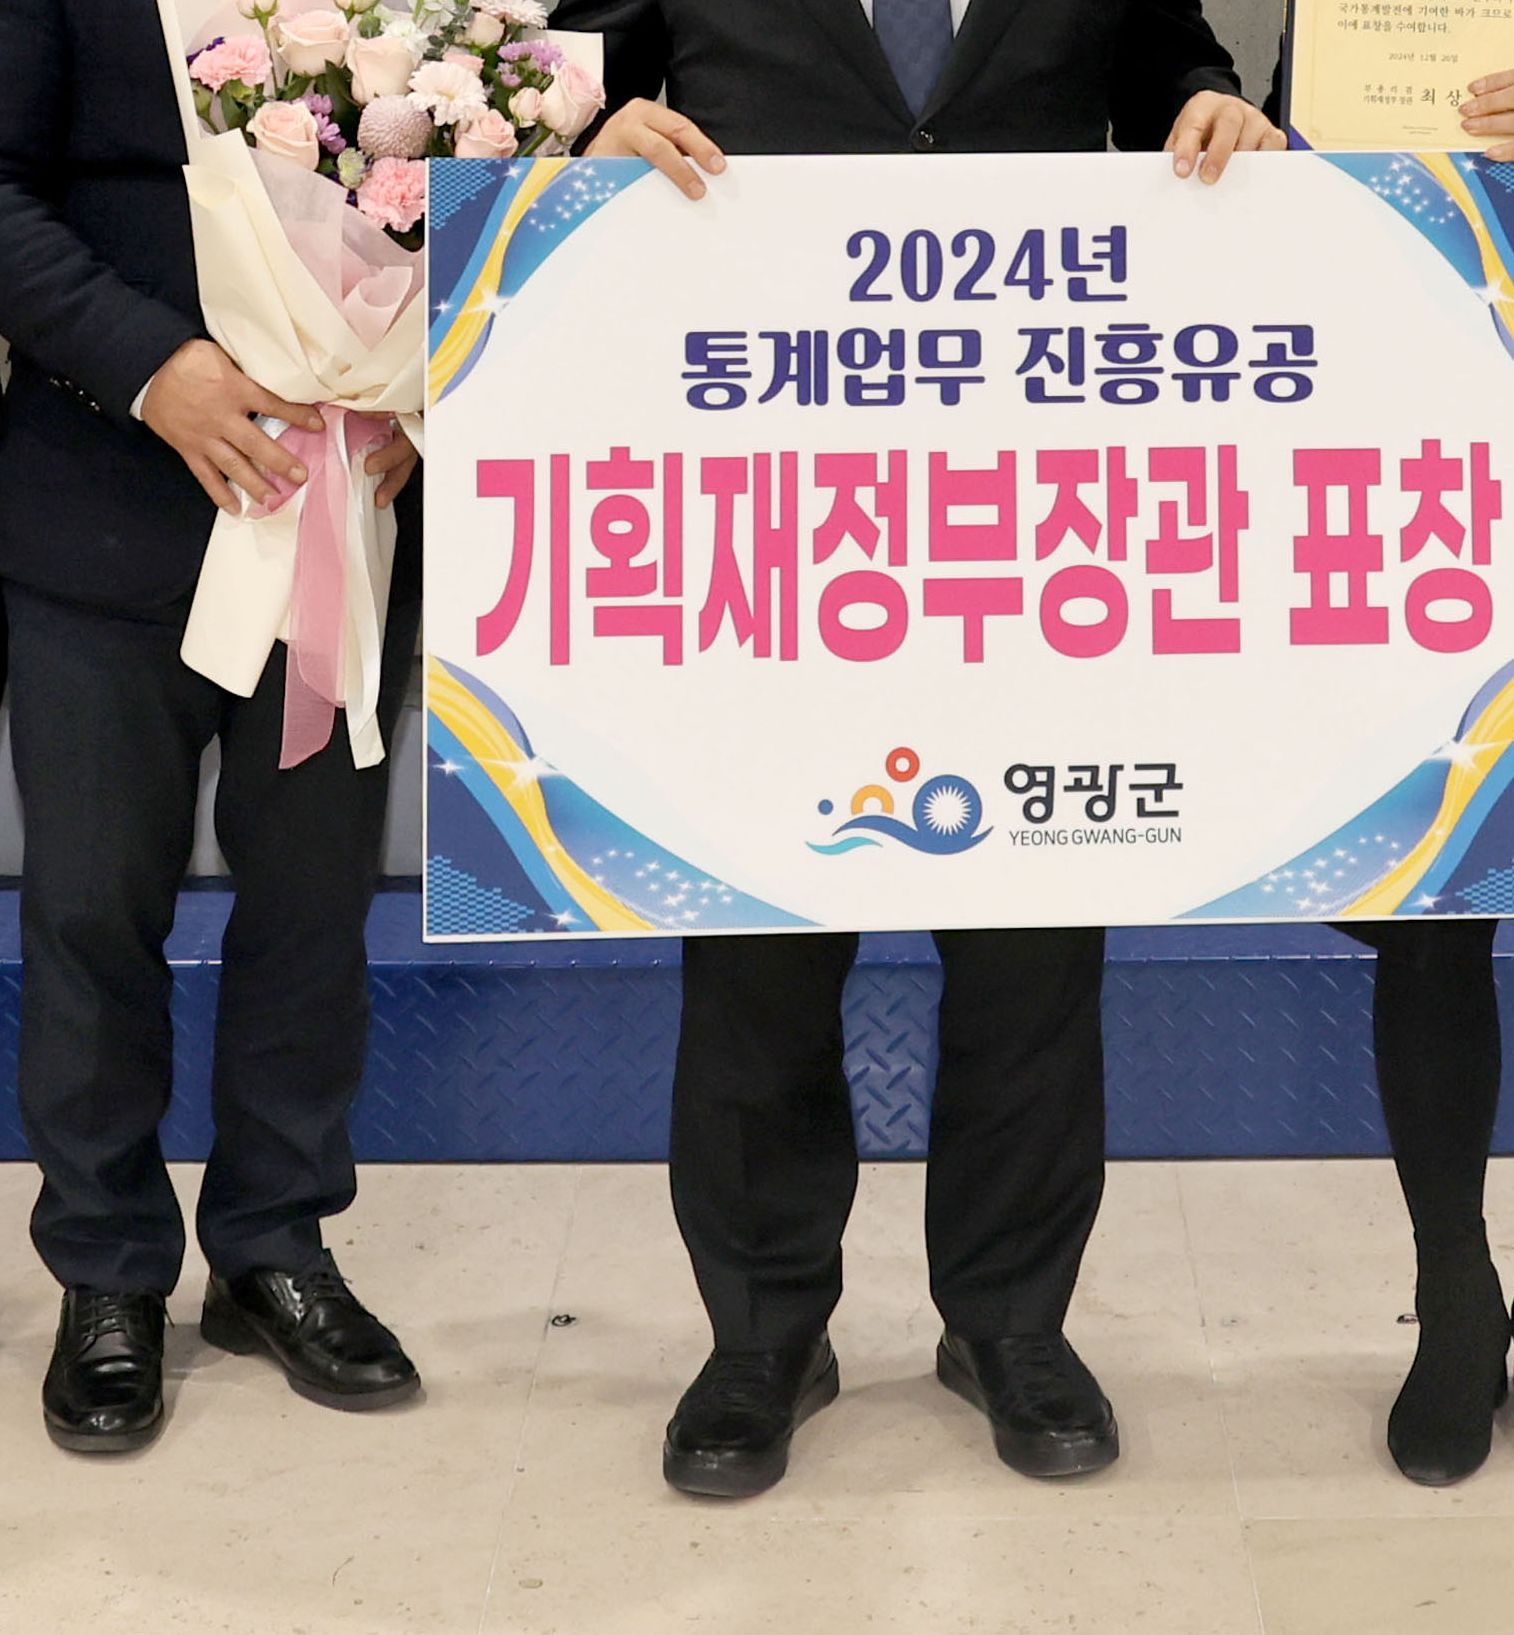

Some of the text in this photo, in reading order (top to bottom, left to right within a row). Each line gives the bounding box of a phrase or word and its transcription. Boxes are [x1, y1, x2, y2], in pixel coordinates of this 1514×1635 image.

[846, 225, 1129, 303] 2024년
[681, 323, 1319, 411] 통계업무 진흥유공
[476, 438, 1503, 667] 기획재정부장관 표창
[1004, 763, 1183, 824] 영광군
